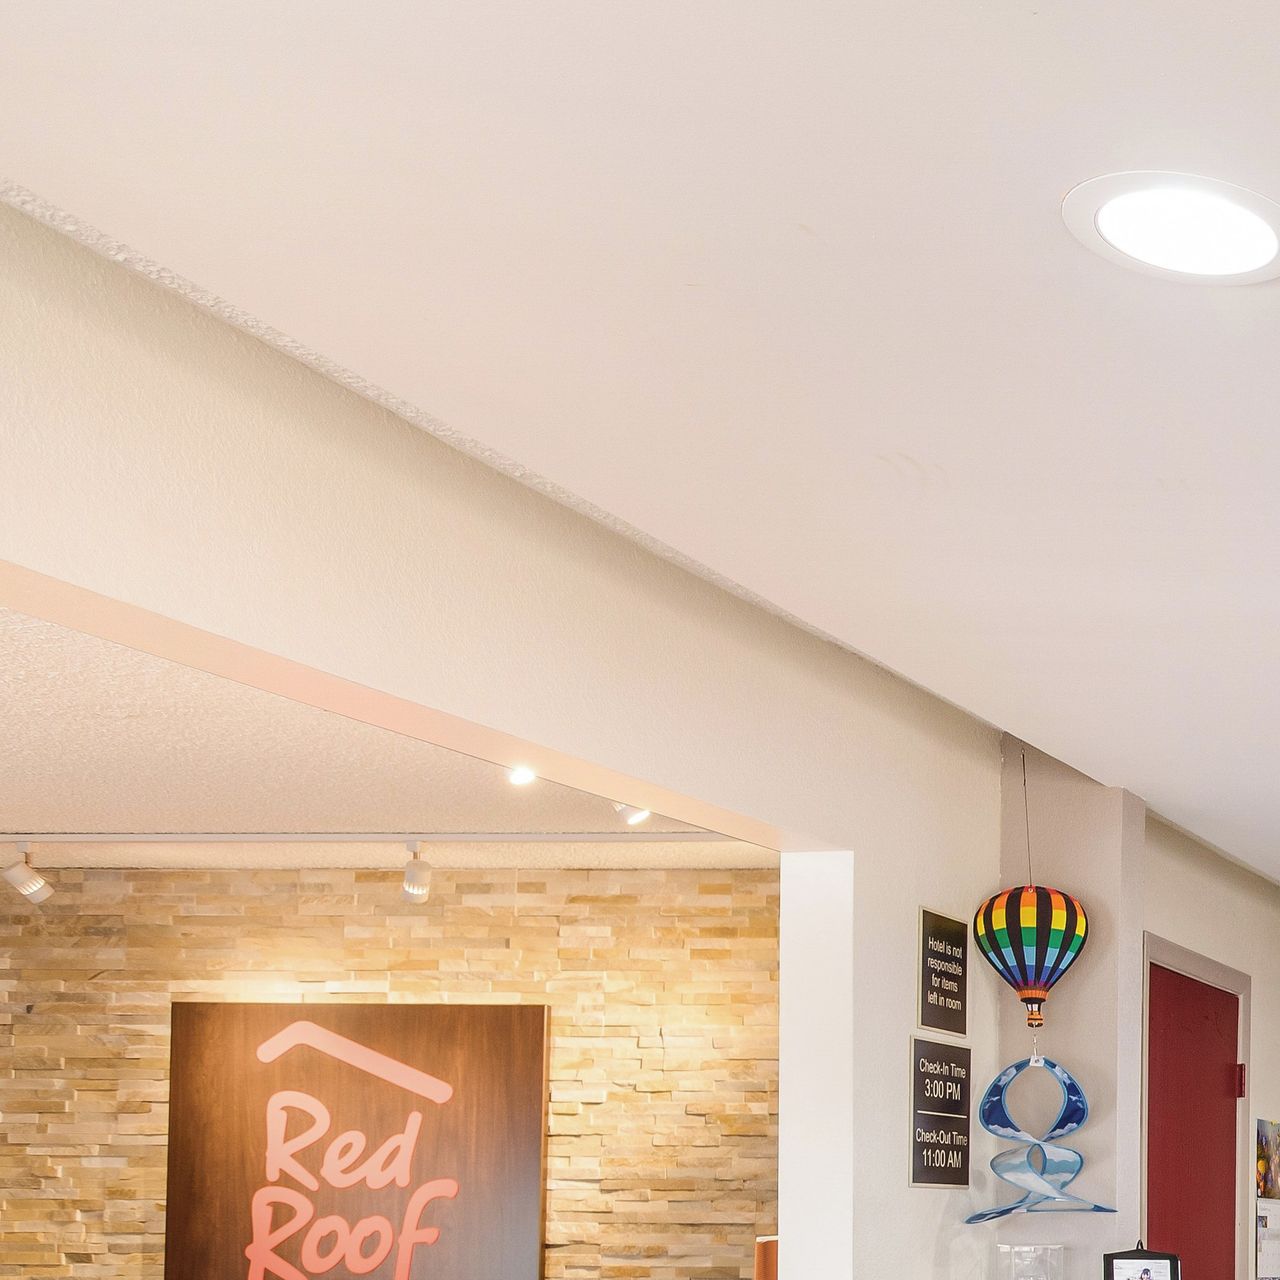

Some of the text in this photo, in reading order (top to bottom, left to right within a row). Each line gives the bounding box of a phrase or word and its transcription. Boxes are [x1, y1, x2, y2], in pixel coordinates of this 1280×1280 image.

[928, 936, 962, 959] Hotel is not
[927, 957, 962, 976] responsible
[931, 973, 958, 992] for items
[927, 990, 961, 1010] left in room
[919, 1058, 966, 1079] Check-In Time
[924, 1078, 961, 1100] 3:00 PM
[265, 1090, 423, 1191] Red
[915, 1127, 968, 1146] Check-Out Time
[922, 1148, 962, 1169] 11:00 AM
